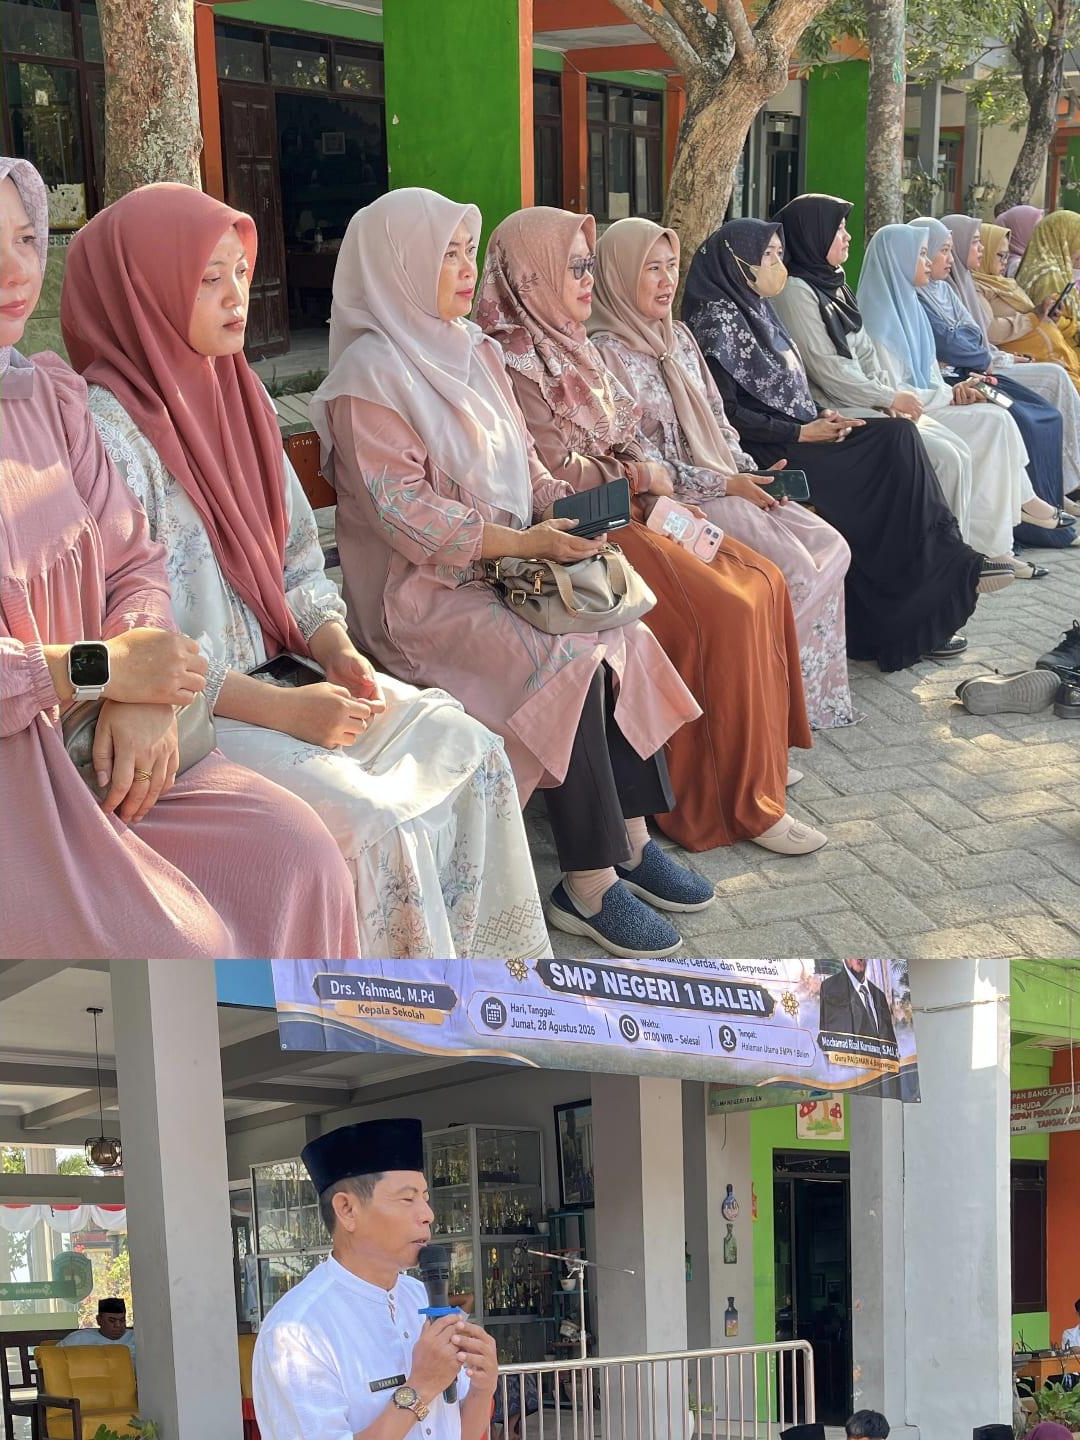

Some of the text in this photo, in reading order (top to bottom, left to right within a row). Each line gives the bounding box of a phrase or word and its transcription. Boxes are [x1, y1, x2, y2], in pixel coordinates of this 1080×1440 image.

[720, 963, 735, 971] dan
[736, 962, 779, 976] Berprestasi
[330, 980, 435, 1004] Drs. Yahmad, M.Pd
[550, 962, 766, 1012] SMP NEGERI 1 BALEN
[358, 1003, 425, 1020] Kepala Sekolah
[510, 1002, 555, 1018] Hari, Tanggal:
[510, 1019, 596, 1036] Jumat, 28 Agustus 2026
[643, 1031, 661, 1042] 07.00
[662, 1033, 674, 1043] WIB
[680, 1035, 701, 1046] Selesai
